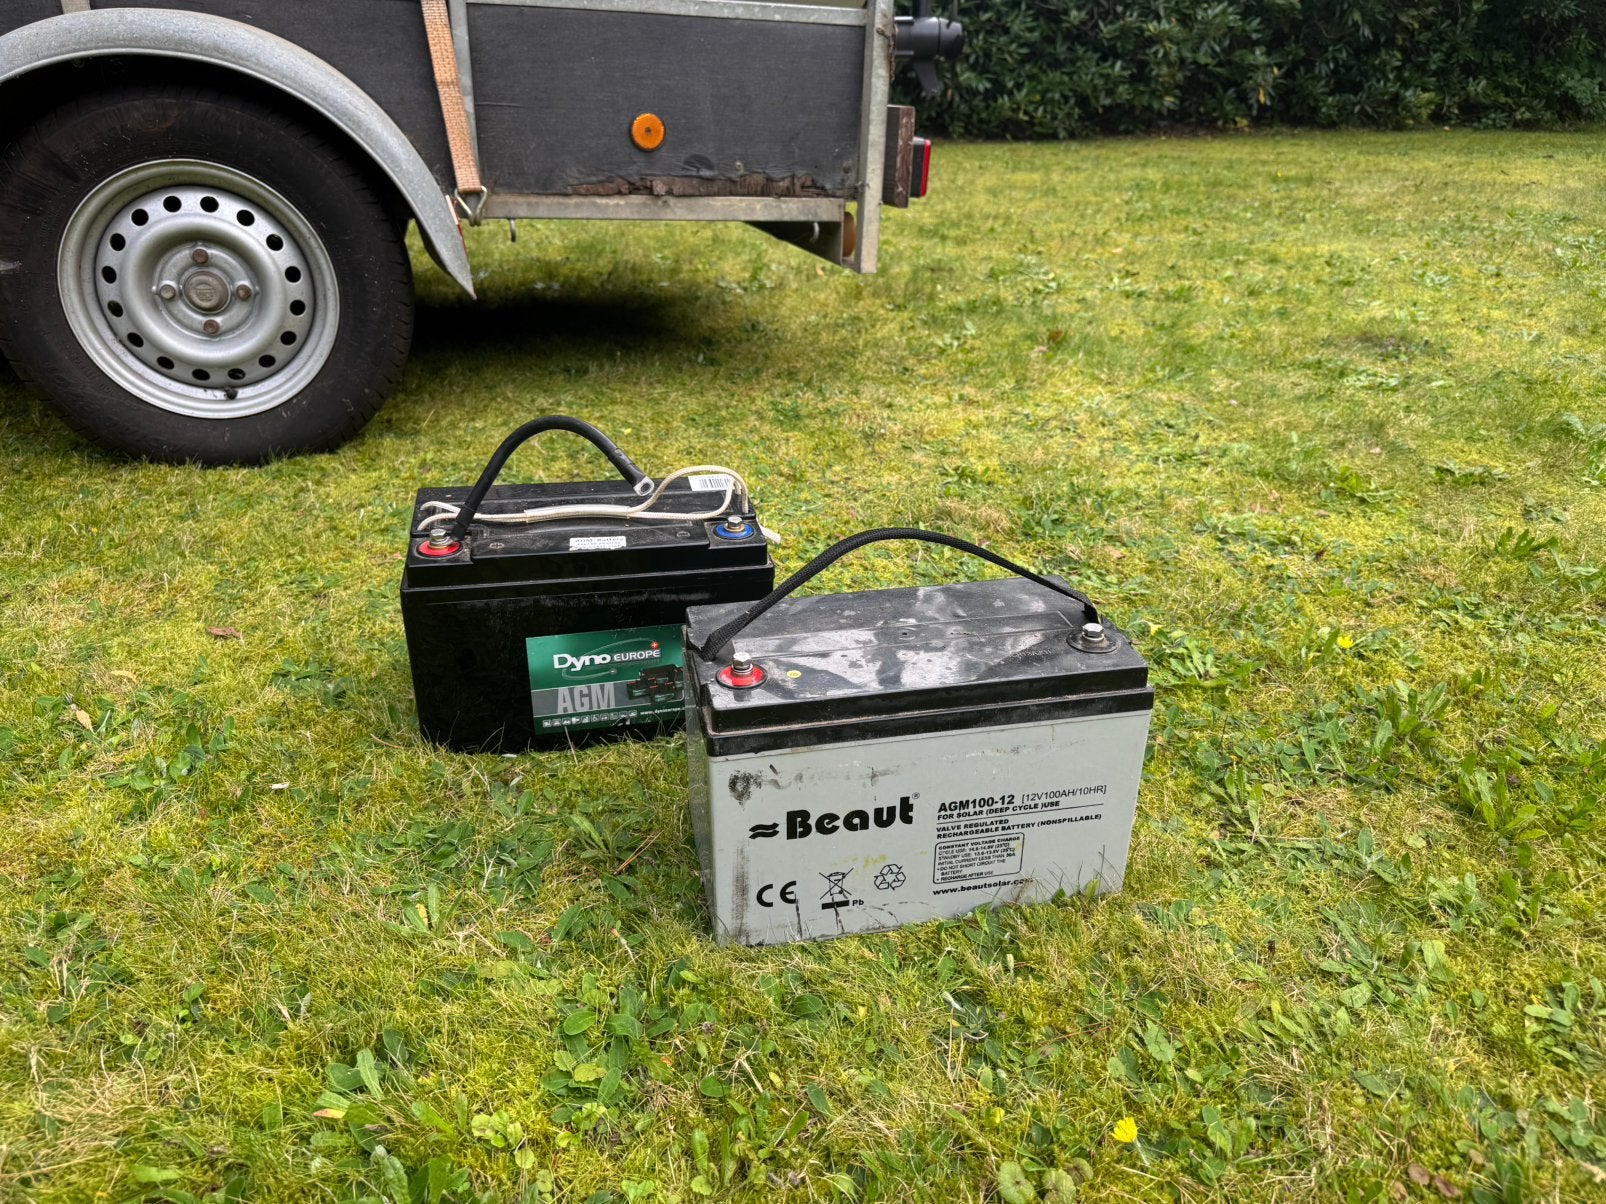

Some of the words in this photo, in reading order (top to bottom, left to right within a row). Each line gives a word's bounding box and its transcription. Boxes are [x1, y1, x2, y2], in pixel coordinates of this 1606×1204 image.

[553, 653, 612, 671] Dyno
[613, 649, 661, 662] EUROPE
[557, 682, 616, 714] AGM
[937, 794, 1015, 813] AGM100-12
[1021, 784, 1107, 804] [12V100AH/10HR]
[786, 796, 915, 841] Beaut
[937, 813, 955, 821] FOR
[956, 809, 984, 819] SOLAR
[985, 806, 1010, 816] (DEEP
[1012, 803, 1039, 812] CYCLE
[936, 824, 961, 833] VALVE
[963, 818, 1009, 829] REGULATED
[936, 826, 1000, 839] RECHARGEABLE
[1001, 822, 1036, 831] BATTERY
[1037, 813, 1102, 828] (NONSPILLABLE)
[938, 842, 969, 850] CONSTANT
[756, 880, 797, 907] CE
